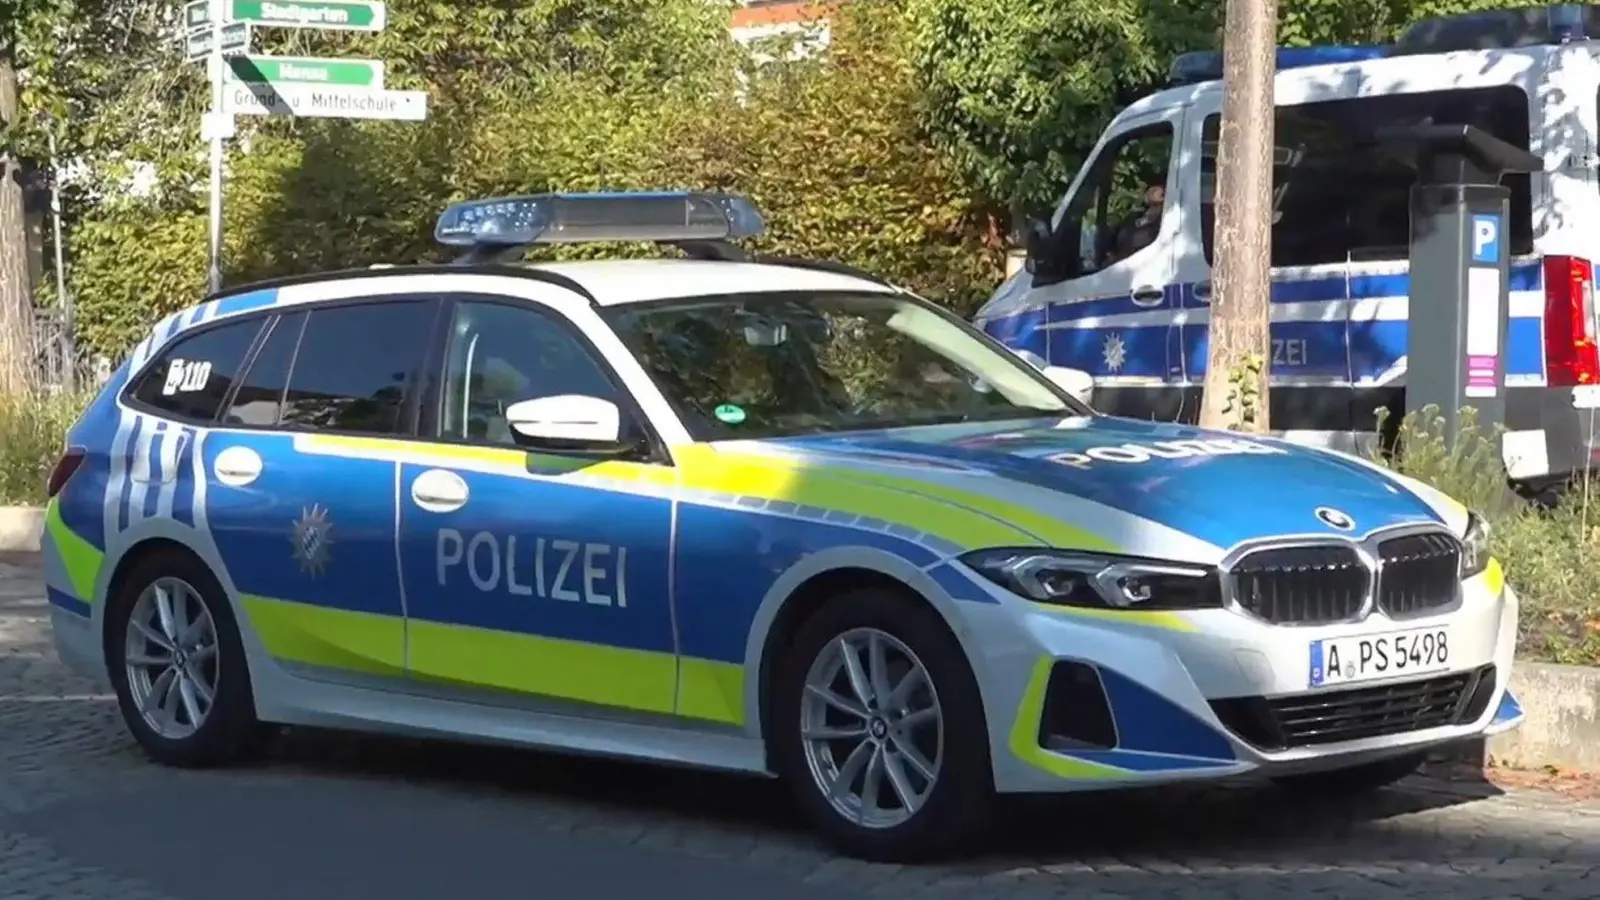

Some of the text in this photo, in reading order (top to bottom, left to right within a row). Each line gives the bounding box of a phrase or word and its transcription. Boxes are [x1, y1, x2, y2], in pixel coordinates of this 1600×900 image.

[261, 2, 348, 24] Stadtgarten
[311, 92, 397, 111] Mittelschule
[180, 361, 212, 391] 110
[436, 527, 628, 609] POLIZEI
[1326, 630, 1449, 677] A PS 5498
